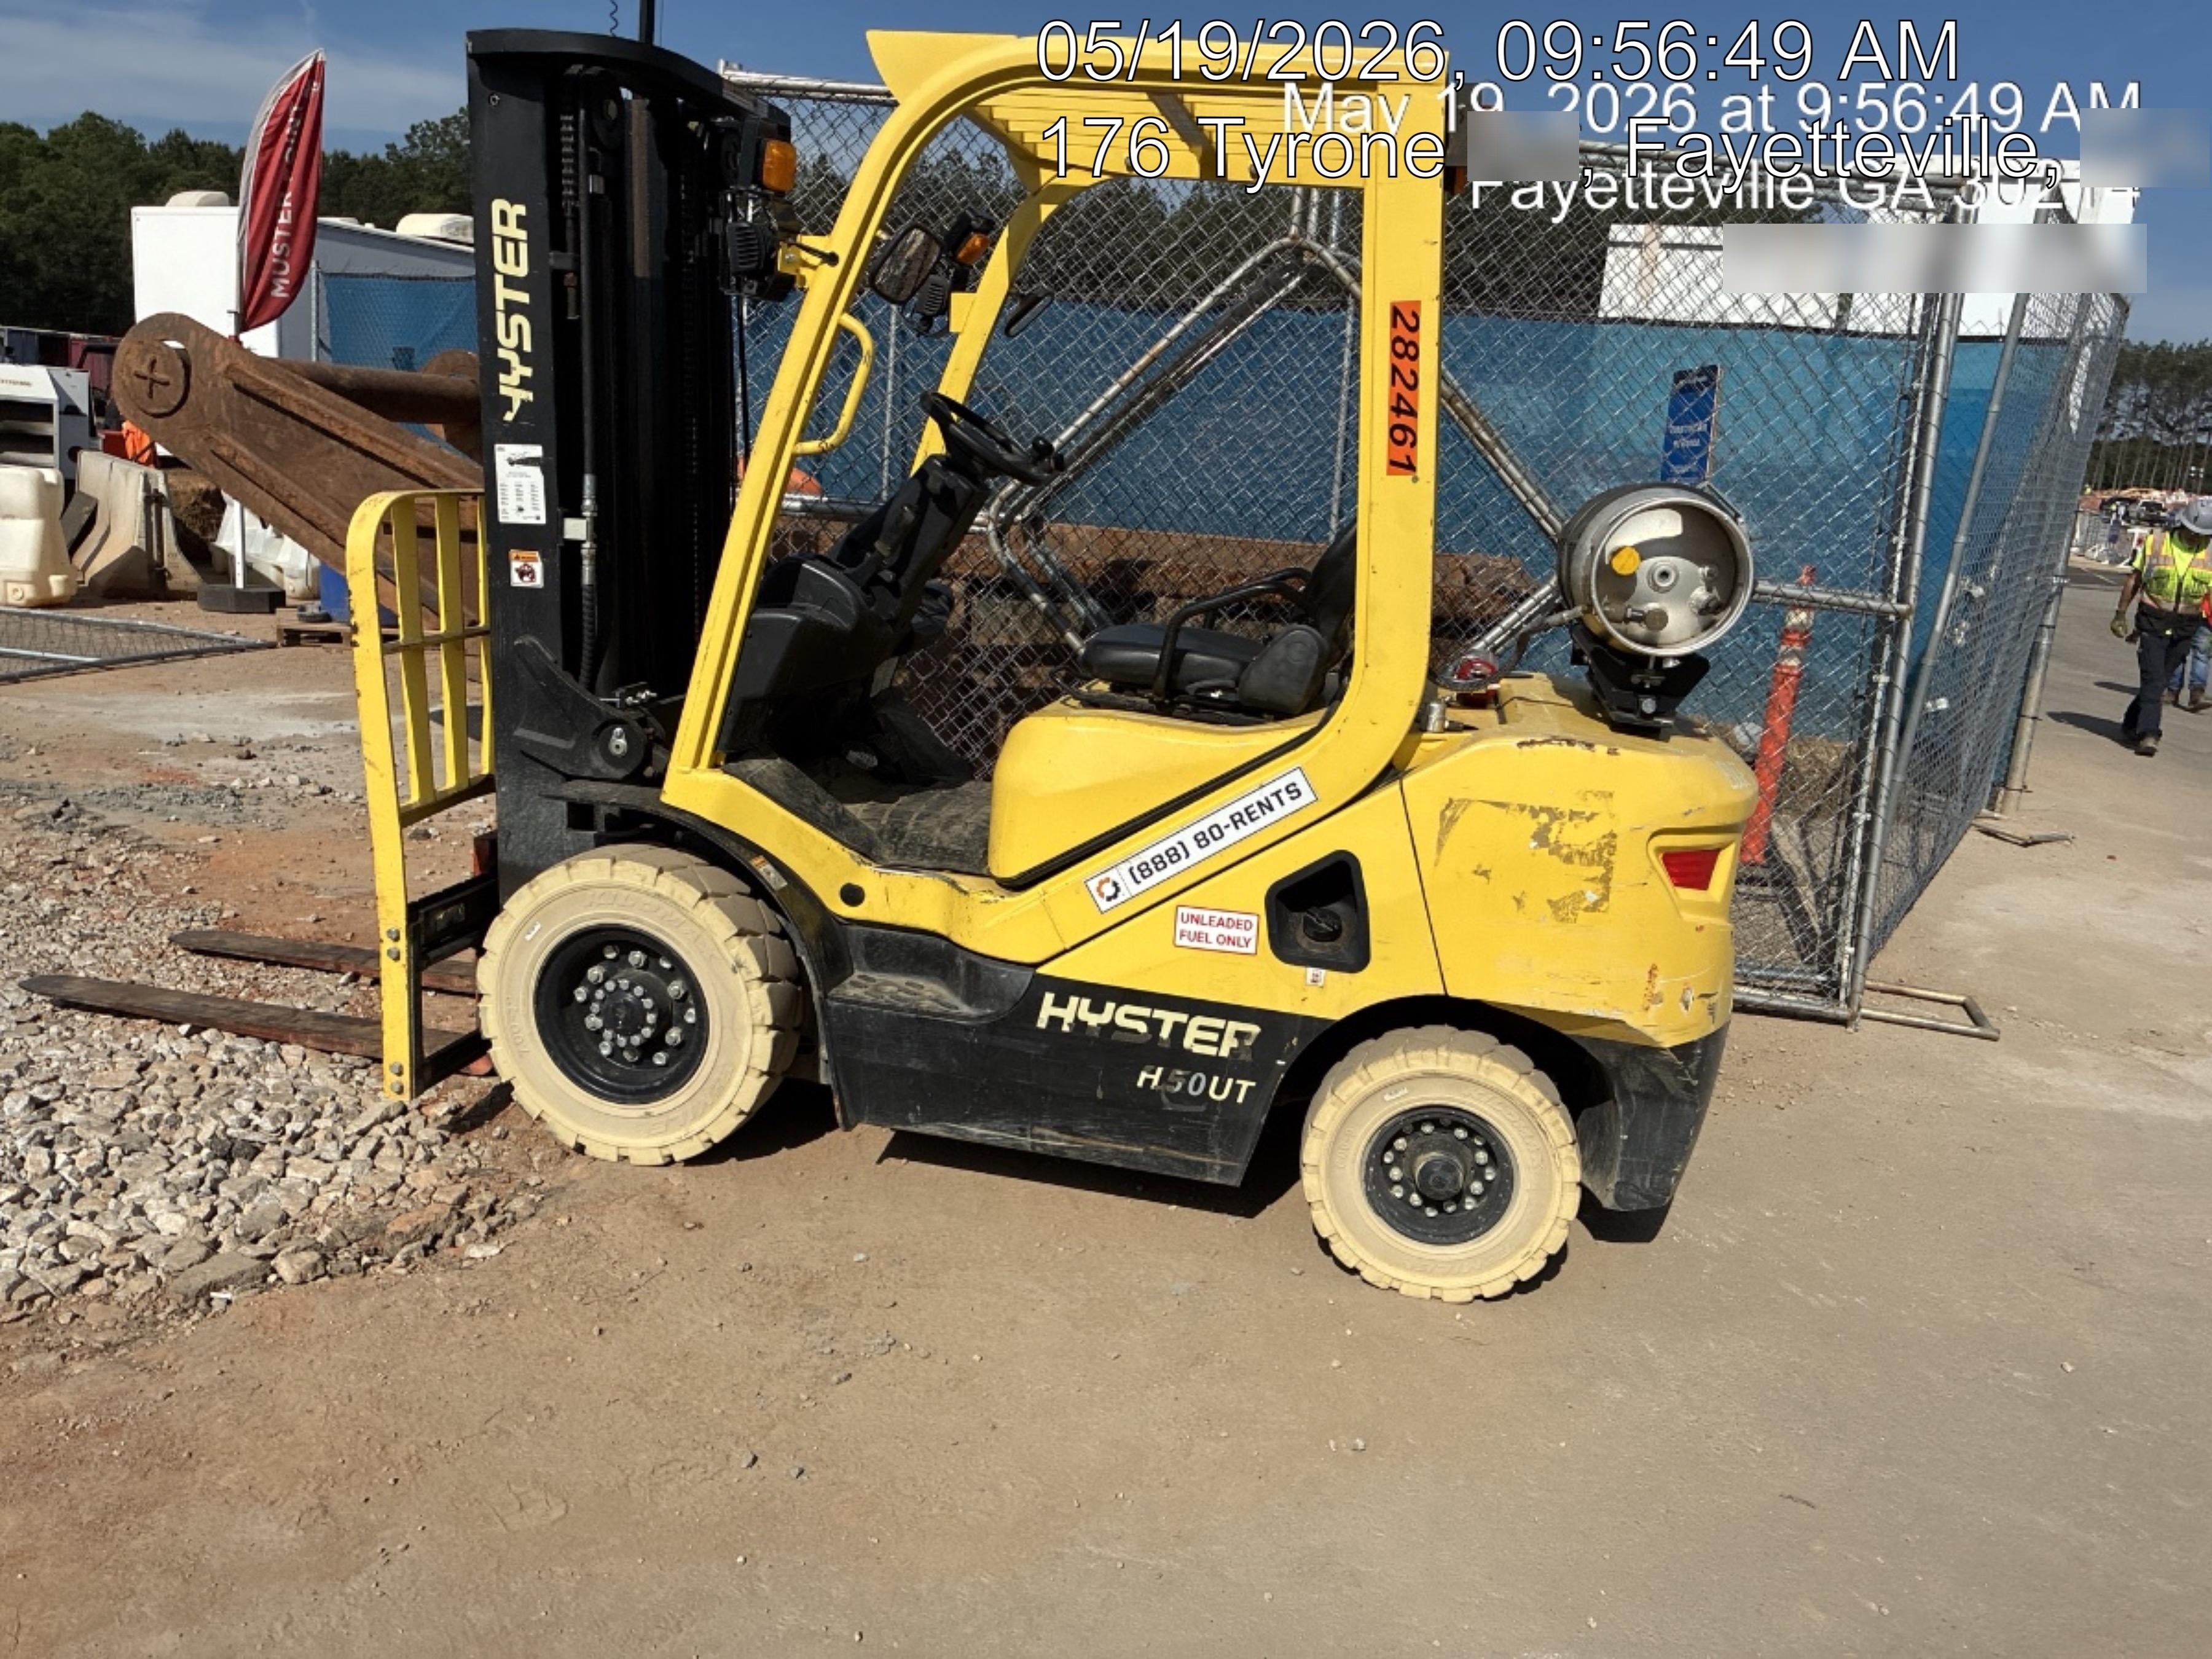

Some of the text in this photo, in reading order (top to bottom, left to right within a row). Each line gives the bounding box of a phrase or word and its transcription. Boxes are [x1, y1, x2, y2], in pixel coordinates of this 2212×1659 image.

[1389, 305, 1421, 474] 282461
[1128, 782, 1303, 885] (888) 80-RENTS
[1179, 929, 1252, 949] FUEL ONLY
[1180, 911, 1253, 931] UNLEADED
[1036, 992, 1261, 1061] HYSTER
